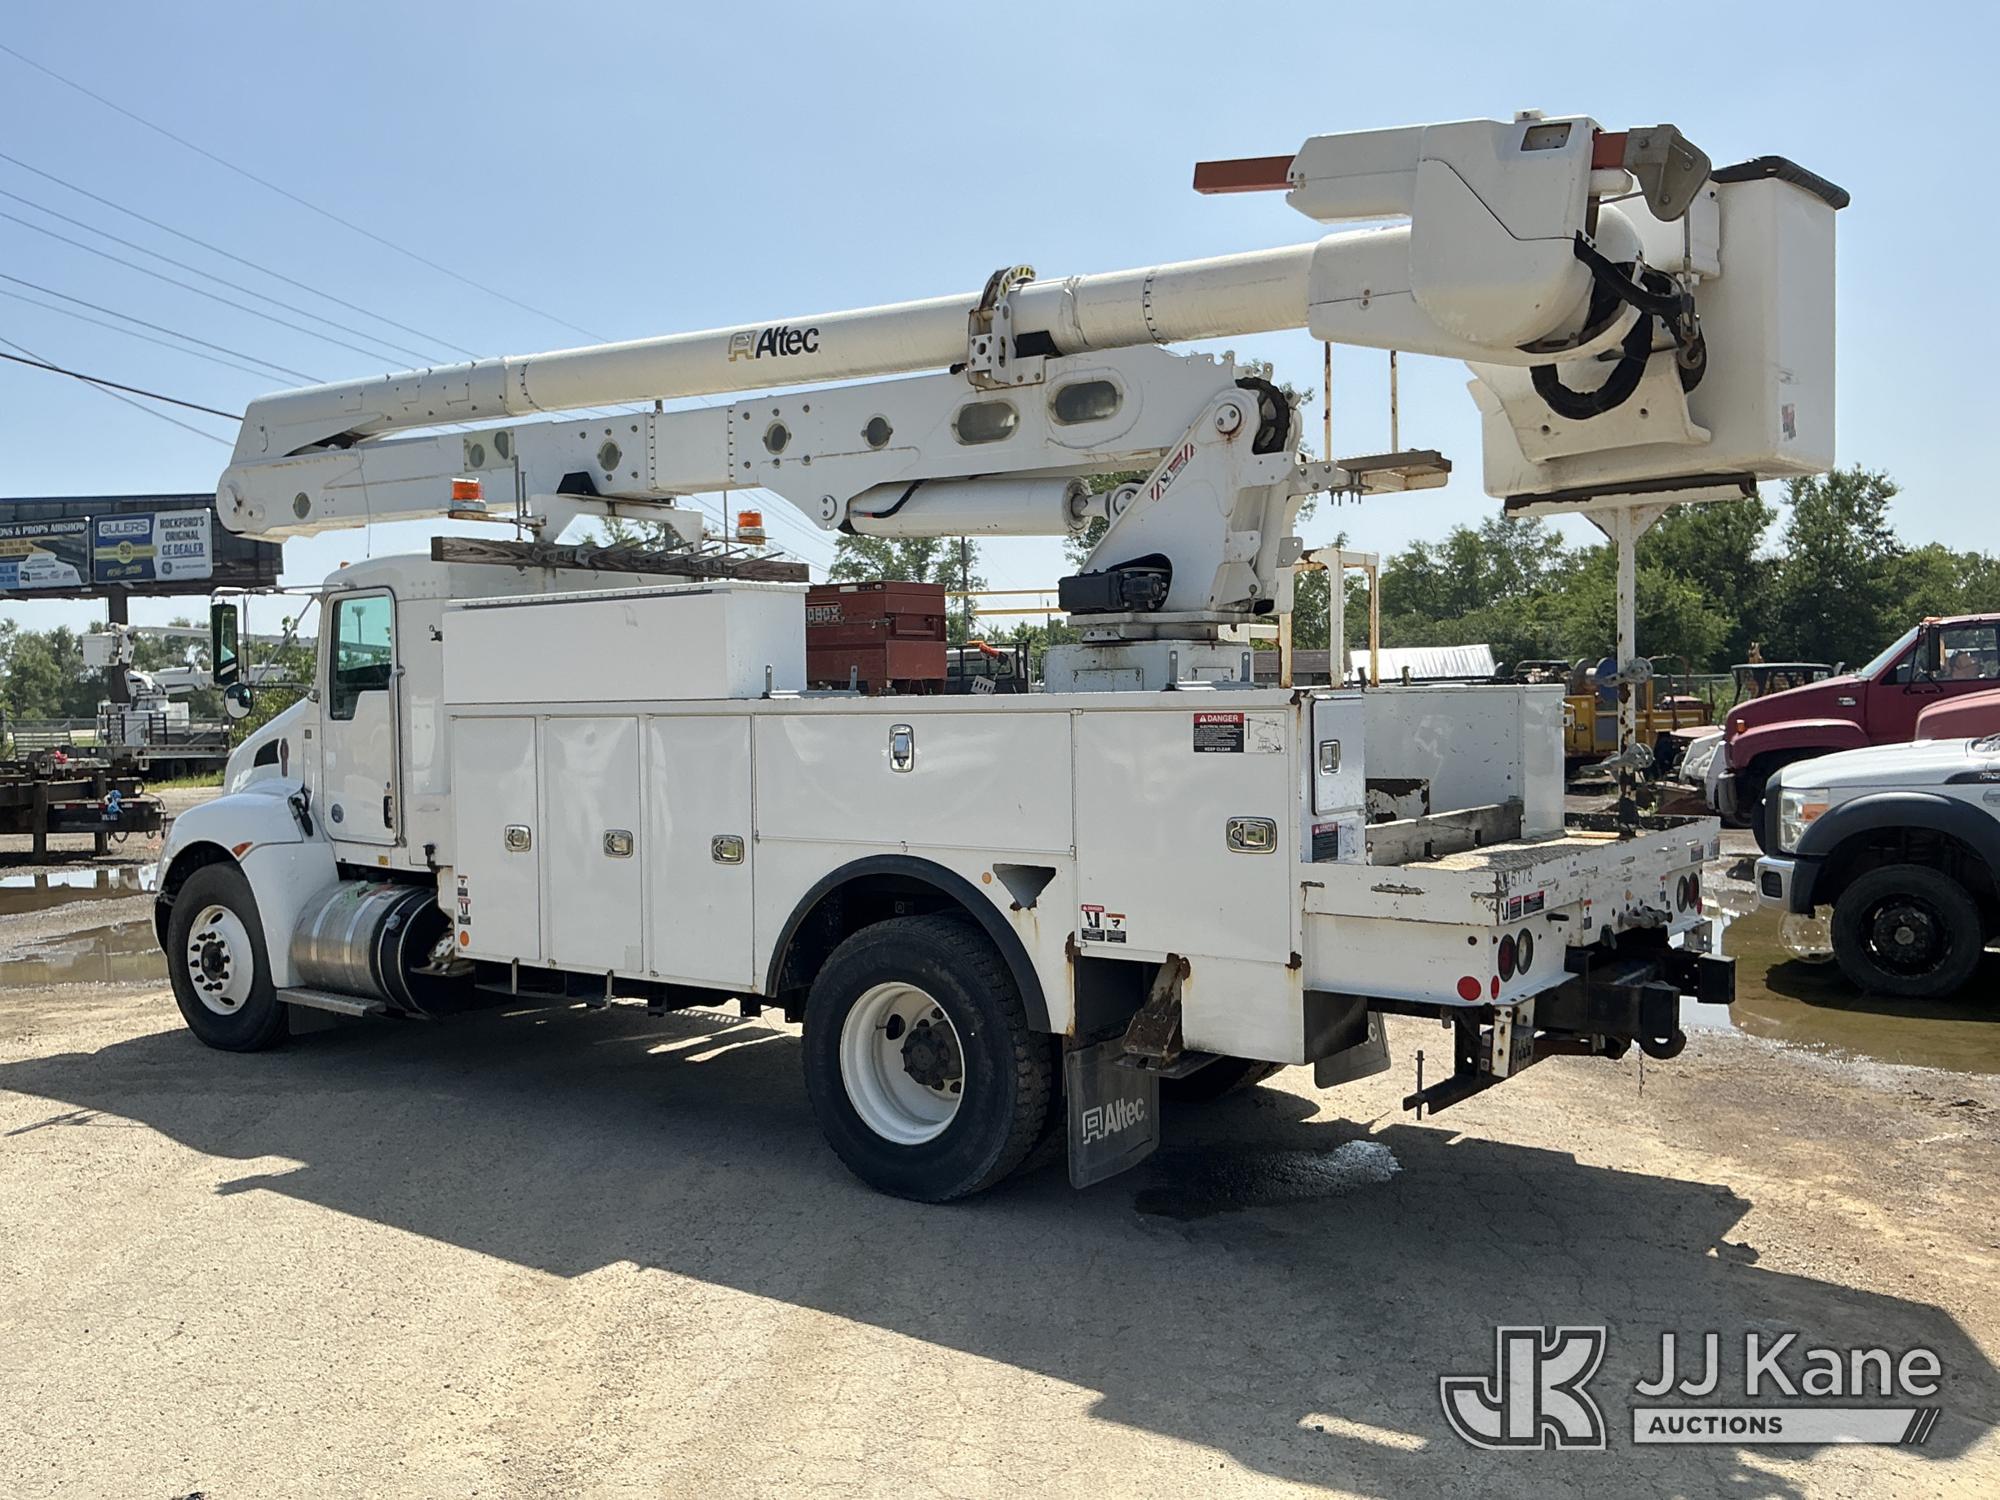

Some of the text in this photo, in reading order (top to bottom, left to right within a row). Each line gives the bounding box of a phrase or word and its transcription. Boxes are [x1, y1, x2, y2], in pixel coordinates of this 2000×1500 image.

[755, 325, 820, 359] Altec
[165, 530, 200, 541] ORIGINAL
[174, 543, 204, 554] DEALER
[1207, 714, 1239, 722] DANGER
[1104, 1097, 1145, 1137] Altec
